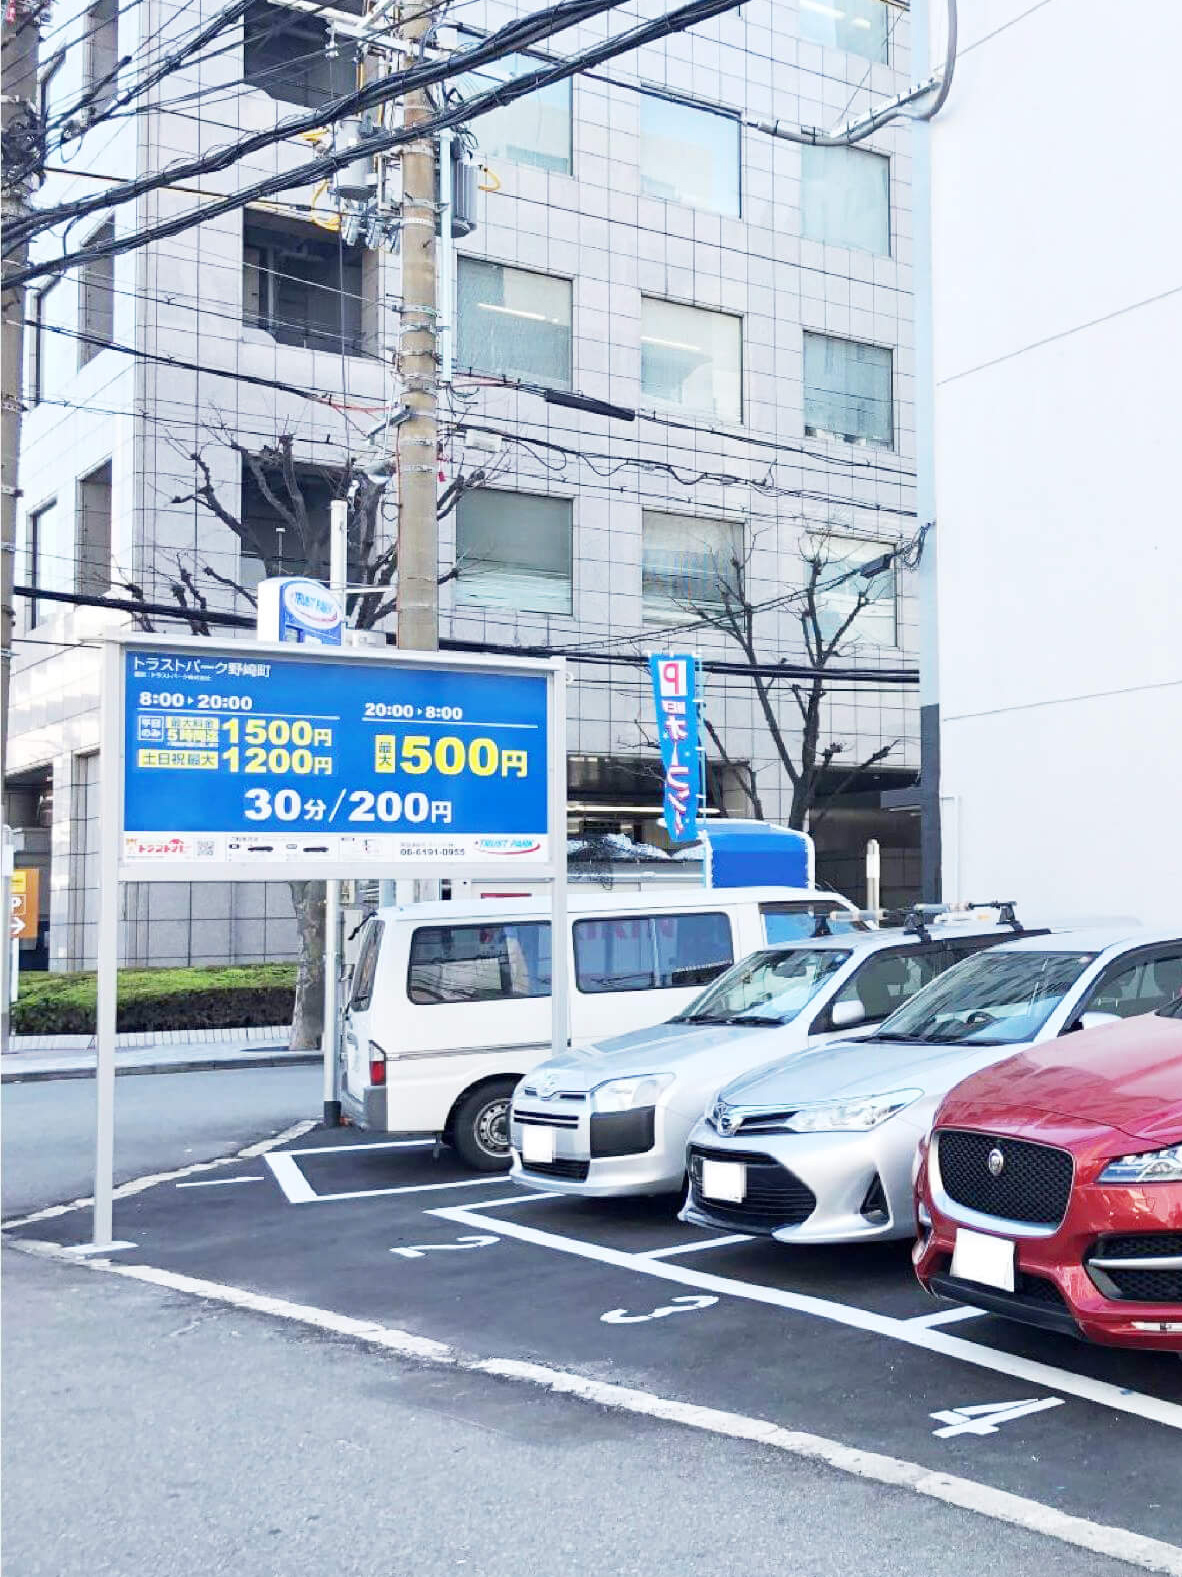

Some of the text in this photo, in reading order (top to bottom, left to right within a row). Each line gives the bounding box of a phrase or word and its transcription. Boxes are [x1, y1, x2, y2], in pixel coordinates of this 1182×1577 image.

[139, 692, 253, 710] 8:00 20:00
[365, 702, 463, 720] 20:00 8:00
[222, 718, 332, 747] 1500円
[141, 751, 216, 766] 土日祝最大
[223, 746, 332, 775] 1200円
[400, 735, 528, 778] 500円
[389, 1235, 501, 1258] 2
[600, 1295, 719, 1325] 3
[930, 1396, 1066, 1438] 4
